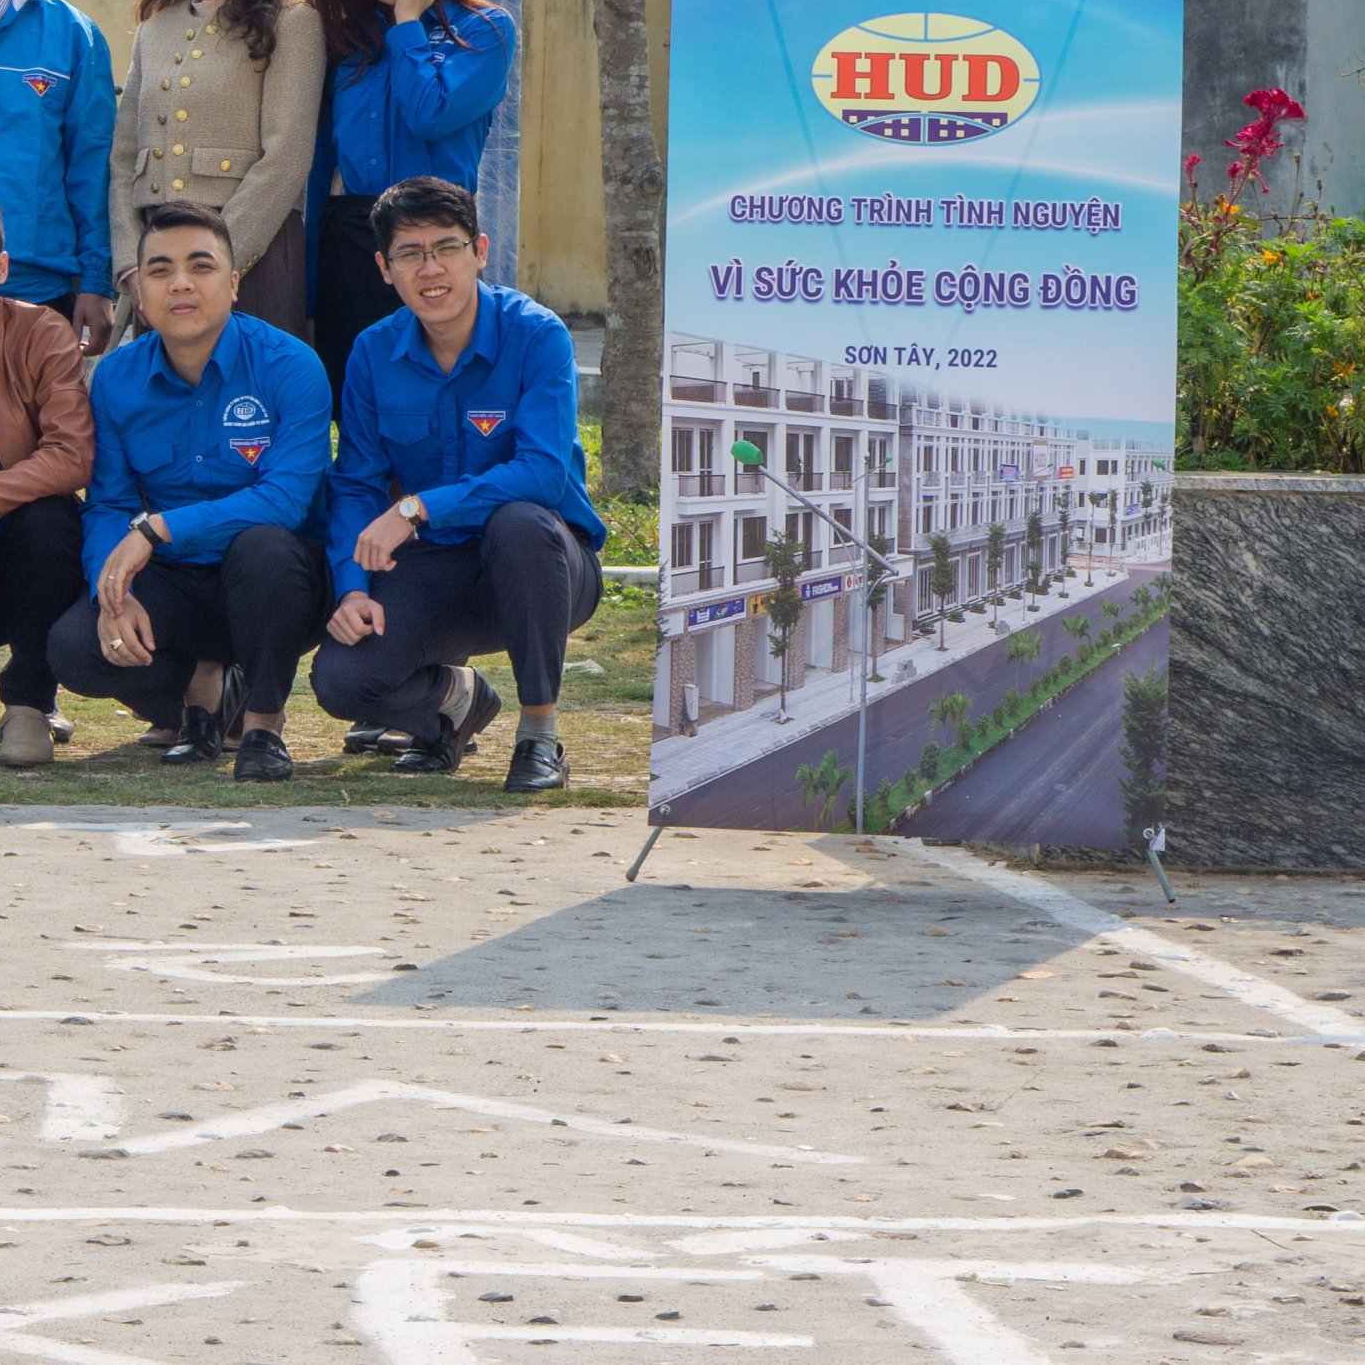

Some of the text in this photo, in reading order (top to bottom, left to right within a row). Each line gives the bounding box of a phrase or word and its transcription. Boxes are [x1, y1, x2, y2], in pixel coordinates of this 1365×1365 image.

[830, 52, 1020, 102] HUD
[729, 193, 1121, 235] CHƯƠNG TRÌNH TÌNH NGUYỆN
[710, 259, 1138, 311] VÌ SỨC KHỎE CỘNG ĐỒNG
[845, 343, 998, 369] SƠN TÂY, 2022
